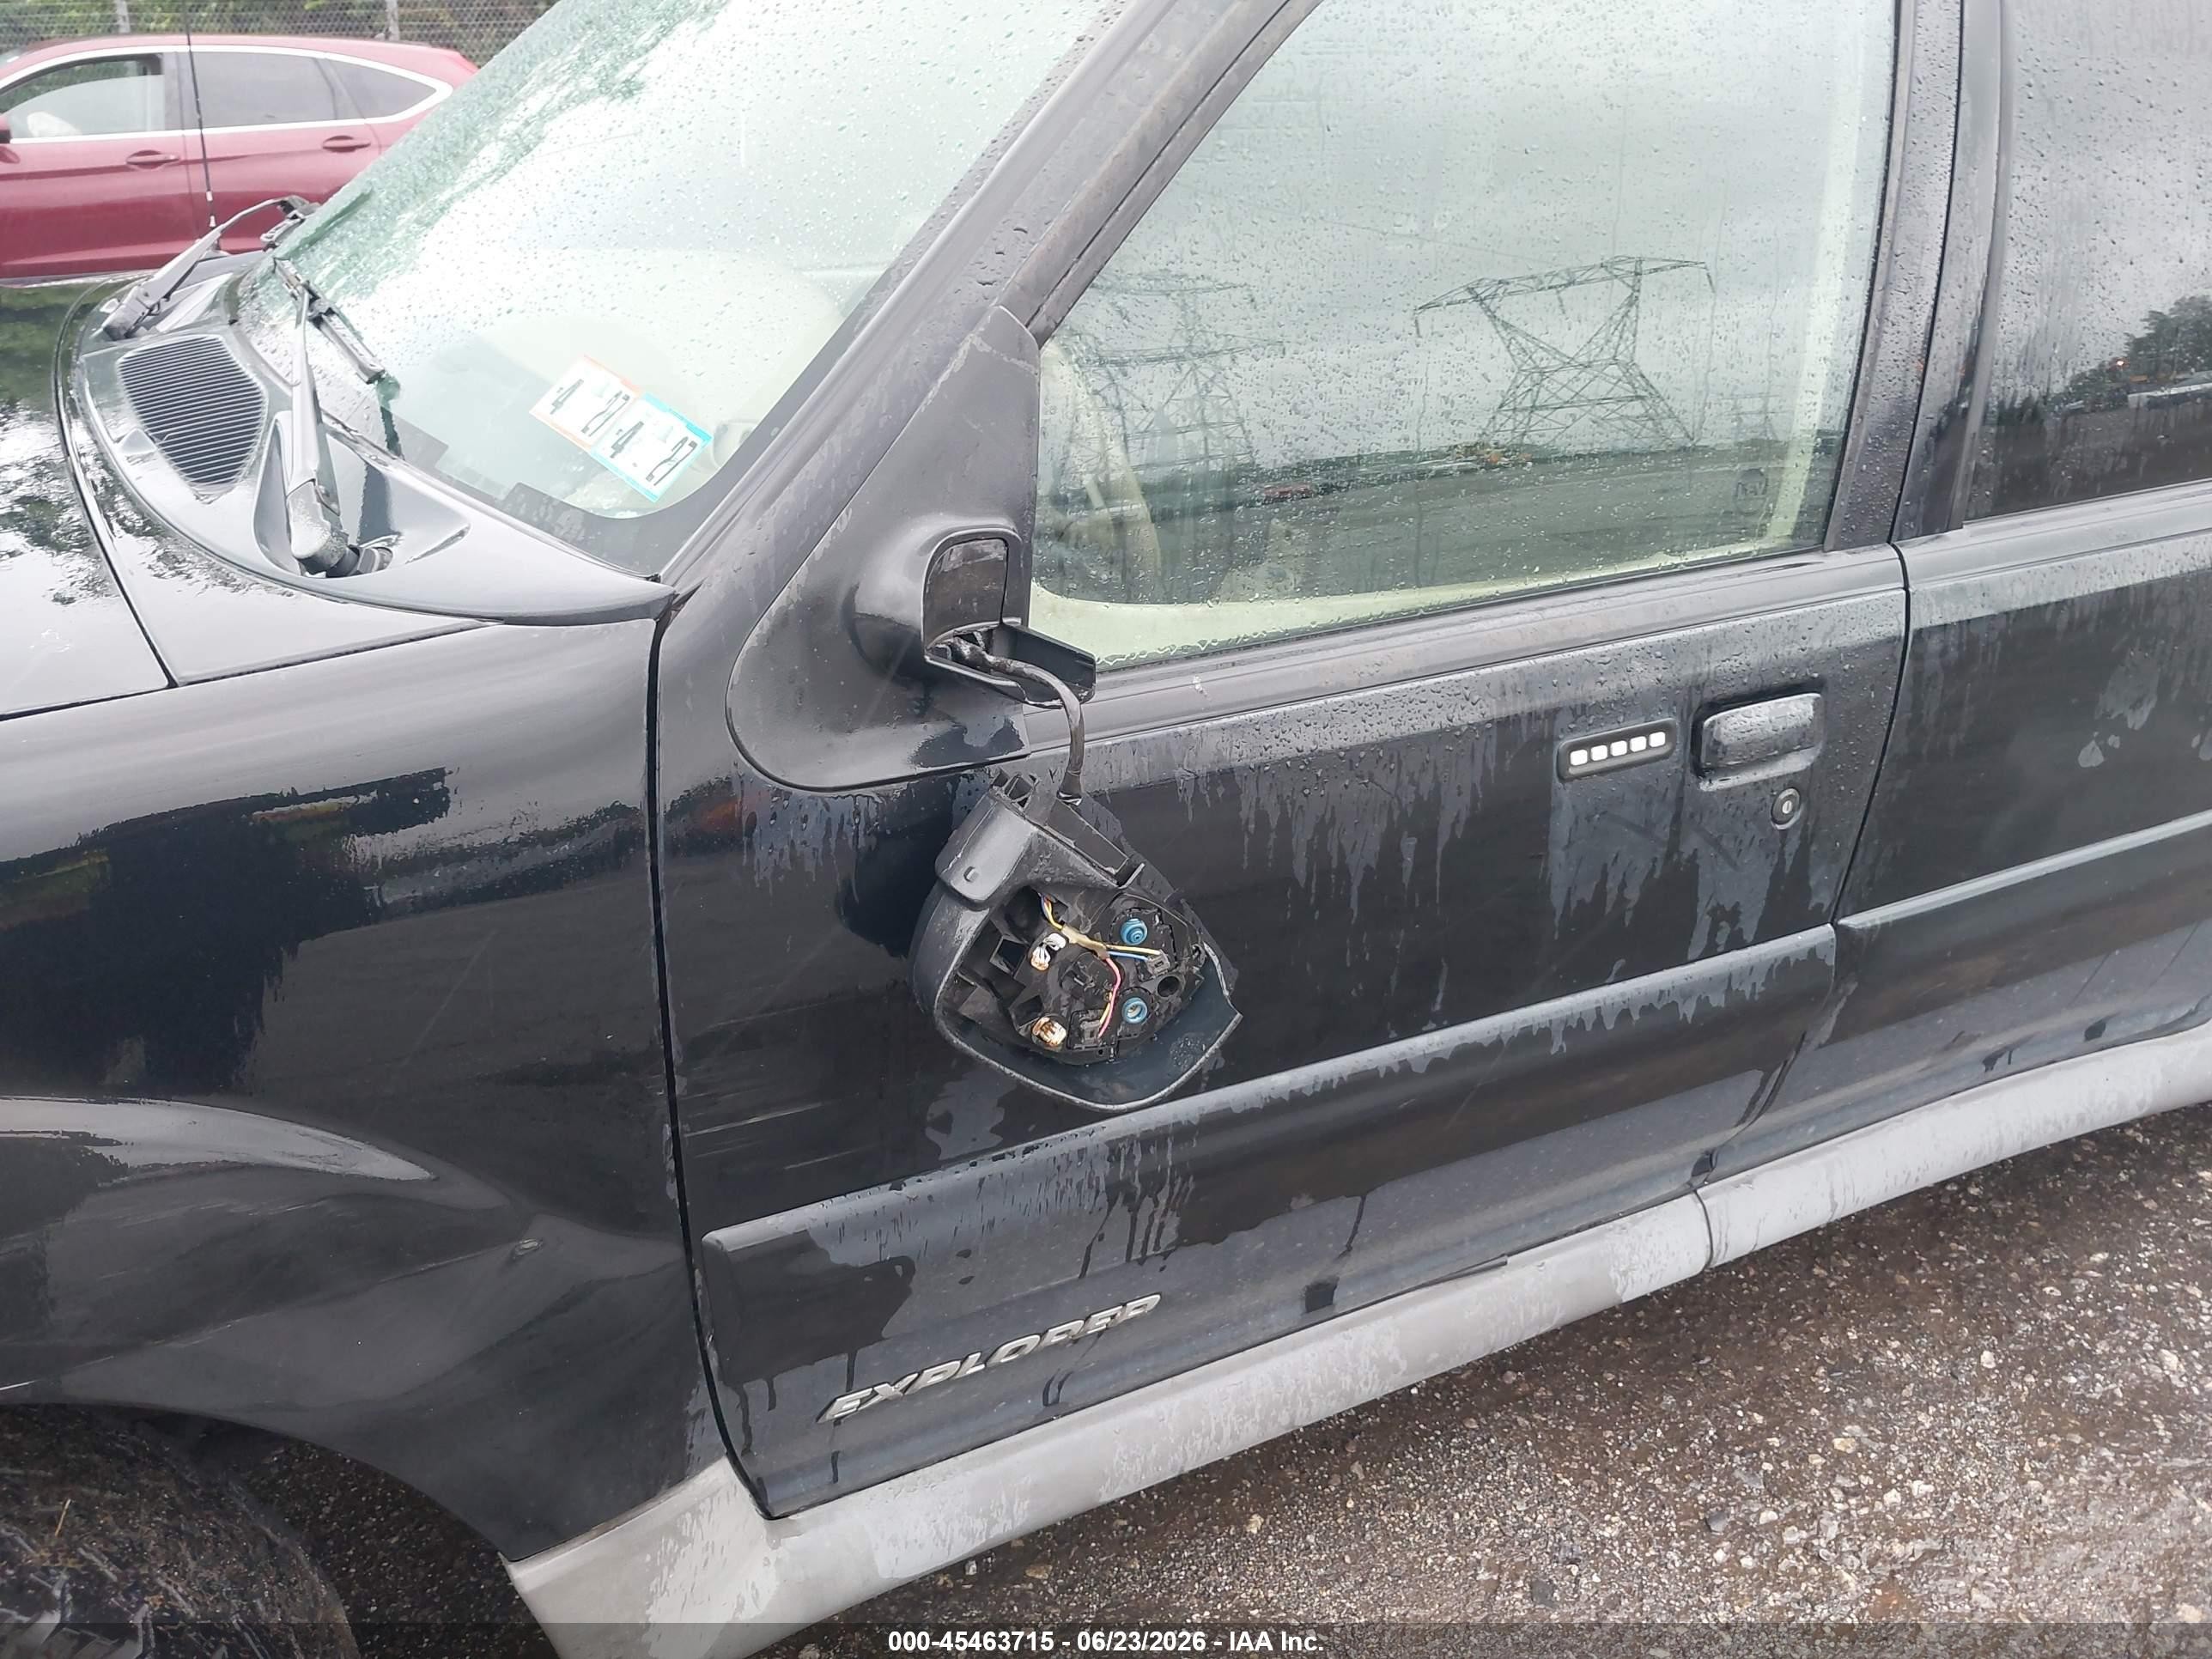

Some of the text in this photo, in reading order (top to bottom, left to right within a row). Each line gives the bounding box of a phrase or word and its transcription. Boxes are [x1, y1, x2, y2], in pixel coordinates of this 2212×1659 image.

[550, 378, 584, 415] 4
[610, 421, 644, 459] 4
[818, 1292, 1162, 1424] EXPLORER
